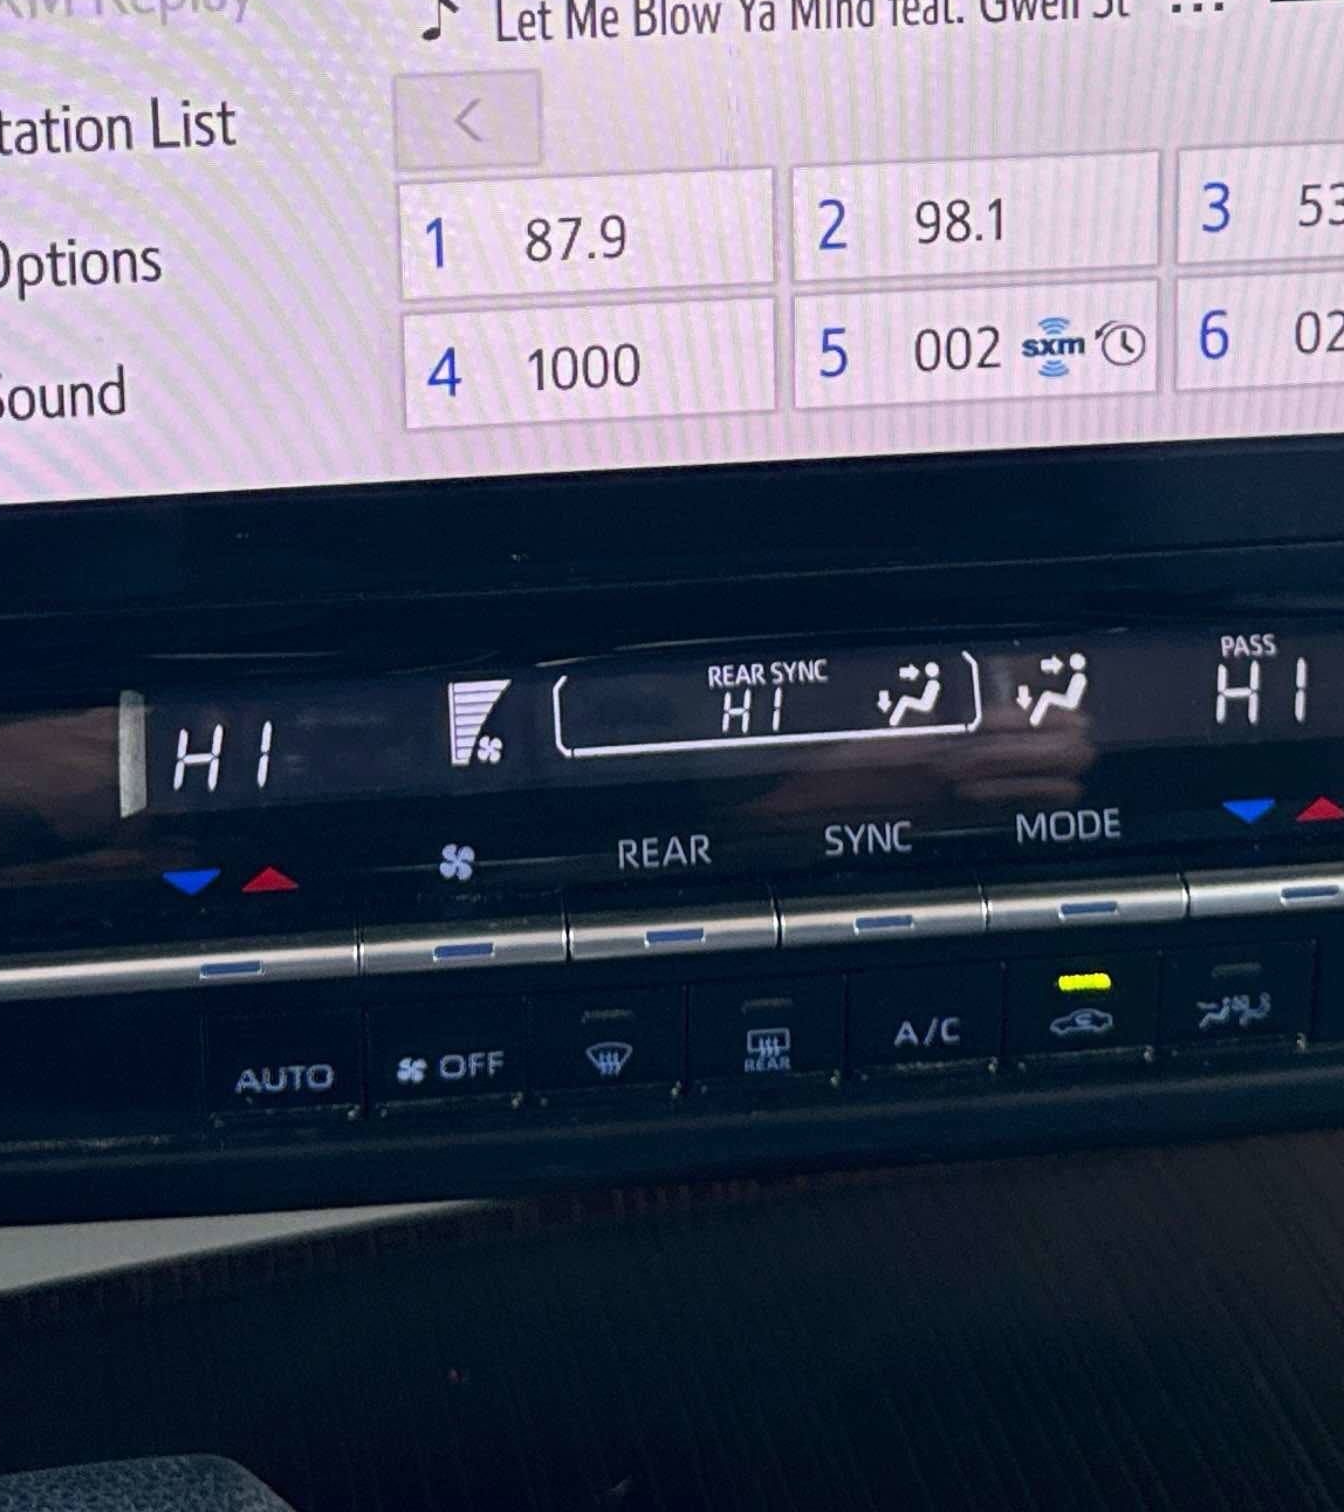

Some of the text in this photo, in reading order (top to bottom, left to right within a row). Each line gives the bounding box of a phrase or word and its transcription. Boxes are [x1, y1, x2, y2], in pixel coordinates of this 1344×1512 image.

[150, 96, 237, 149] List
[818, 197, 1004, 251] 2 98.1
[1201, 181, 1232, 234] 3
[425, 214, 627, 269] 1 87.9
[819, 326, 1086, 379] 5 002 sxm
[1199, 309, 1230, 361] 6
[427, 343, 641, 397] 4 1000
[1219, 633, 1277, 658] PASS
[707, 658, 829, 689] REAR SYNC
[823, 821, 914, 857] SYNC
[1015, 807, 1122, 844] MODE
[617, 834, 712, 869] REAR
[893, 1016, 962, 1048] A/C
[234, 1063, 336, 1094] AUTO
[438, 1050, 505, 1079] OFF
[743, 1055, 792, 1073] REAR
